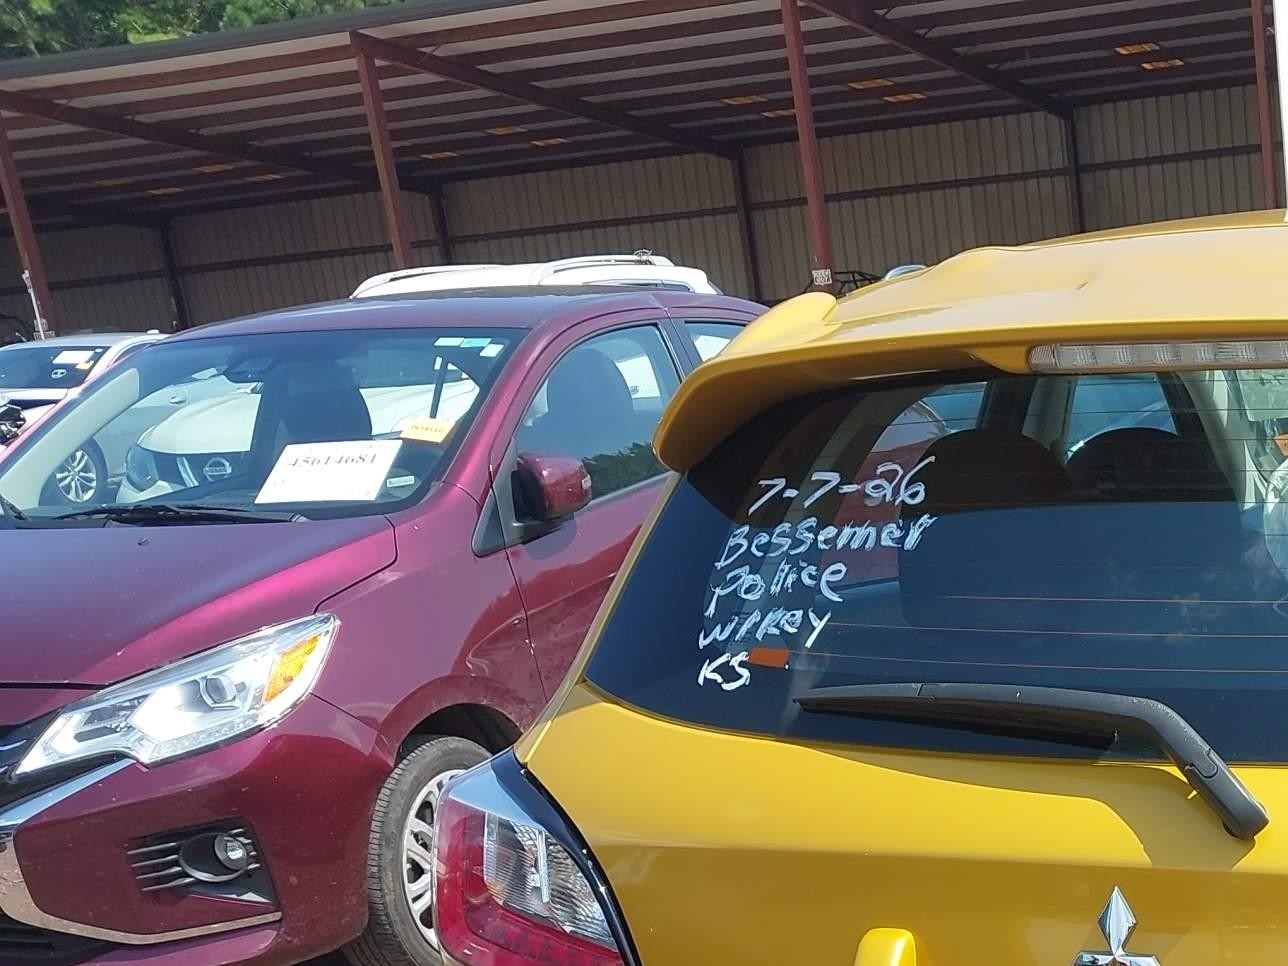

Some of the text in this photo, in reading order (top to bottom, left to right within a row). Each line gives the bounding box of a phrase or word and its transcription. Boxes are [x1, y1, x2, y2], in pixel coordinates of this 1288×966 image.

[747, 456, 937, 516] 7-7-26
[714, 513, 938, 570] Bessemer
[697, 651, 751, 691] KS
